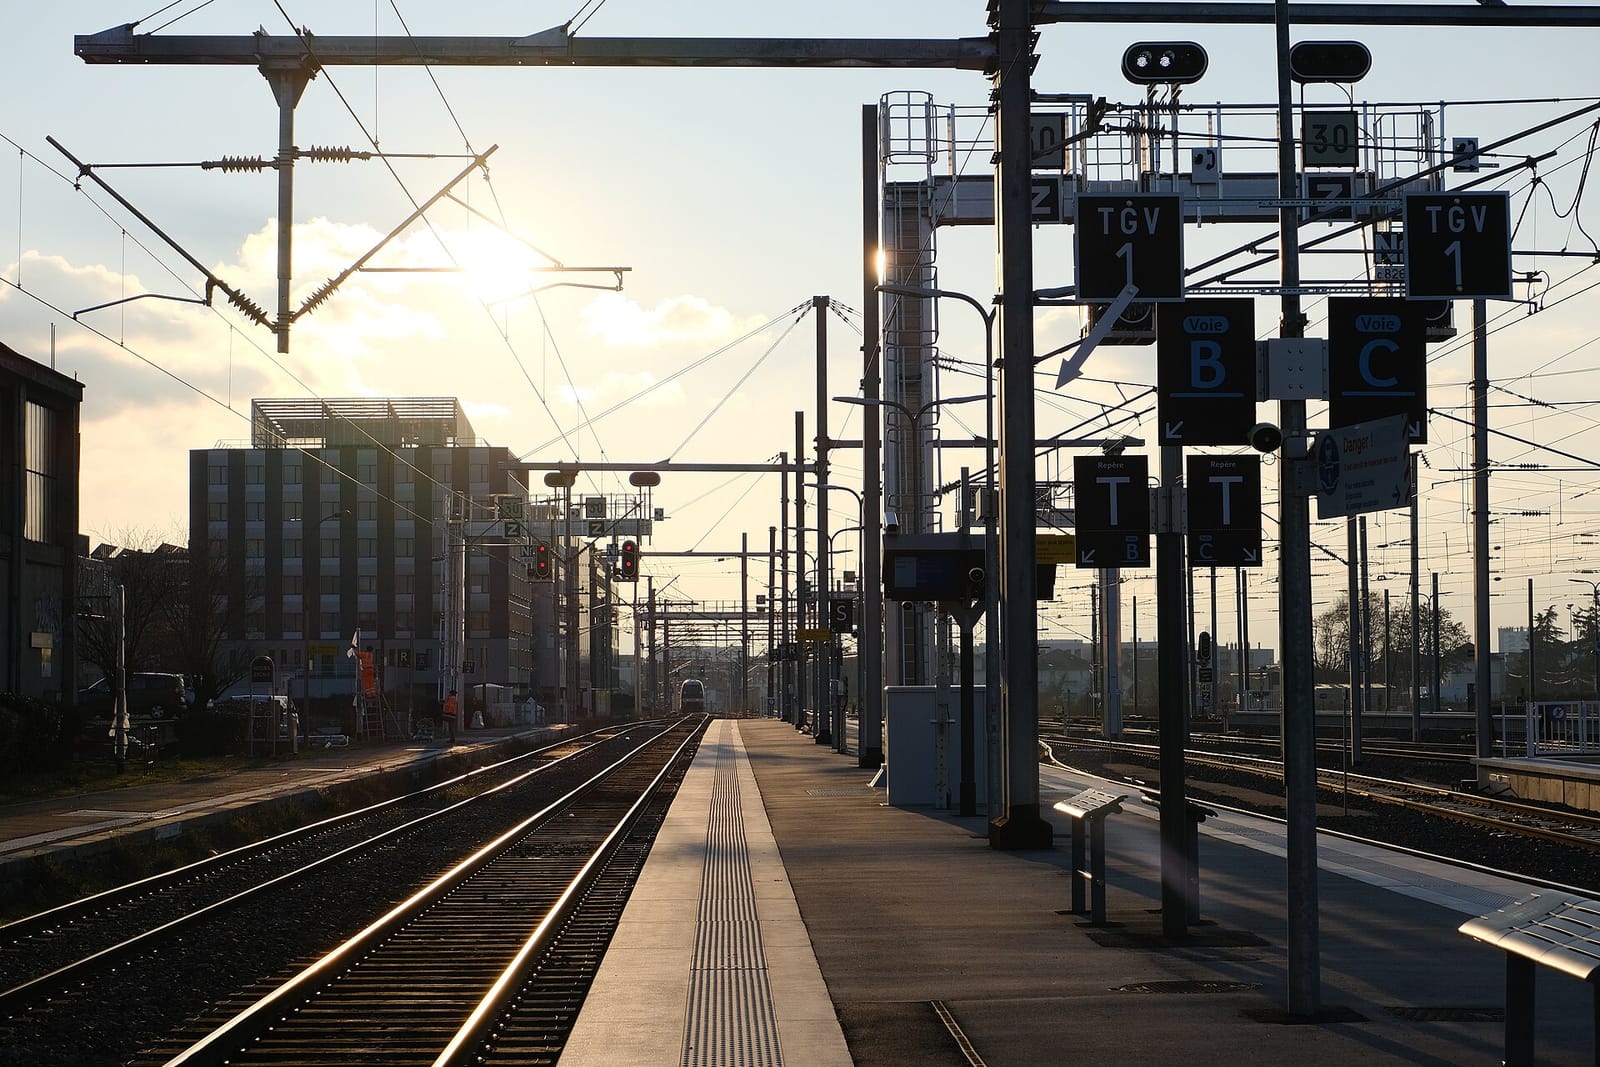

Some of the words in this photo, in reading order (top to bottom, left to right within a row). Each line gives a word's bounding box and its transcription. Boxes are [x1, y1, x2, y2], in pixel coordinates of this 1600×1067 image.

[1030, 127, 1055, 158] 0
[1312, 124, 1350, 154] 30
[1031, 185, 1052, 215] Z
[1097, 207, 1160, 235] TGV
[1425, 205, 1488, 233] TGV
[1115, 242, 1134, 285] 1
[1443, 240, 1462, 286] 1
[1189, 318, 1223, 331] Voie
[1361, 317, 1395, 331] Voie
[1189, 339, 1226, 389] B
[1359, 338, 1400, 388] C
[1343, 436, 1369, 454] Danger
[1097, 461, 1125, 470] Repère
[1210, 461, 1237, 470] Repère
[1095, 476, 1131, 526] T
[1208, 475, 1243, 525] T
[1126, 544, 1139, 560] B
[1199, 543, 1213, 560] C
[836, 605, 847, 621] S
[400, 652, 408, 662] R
